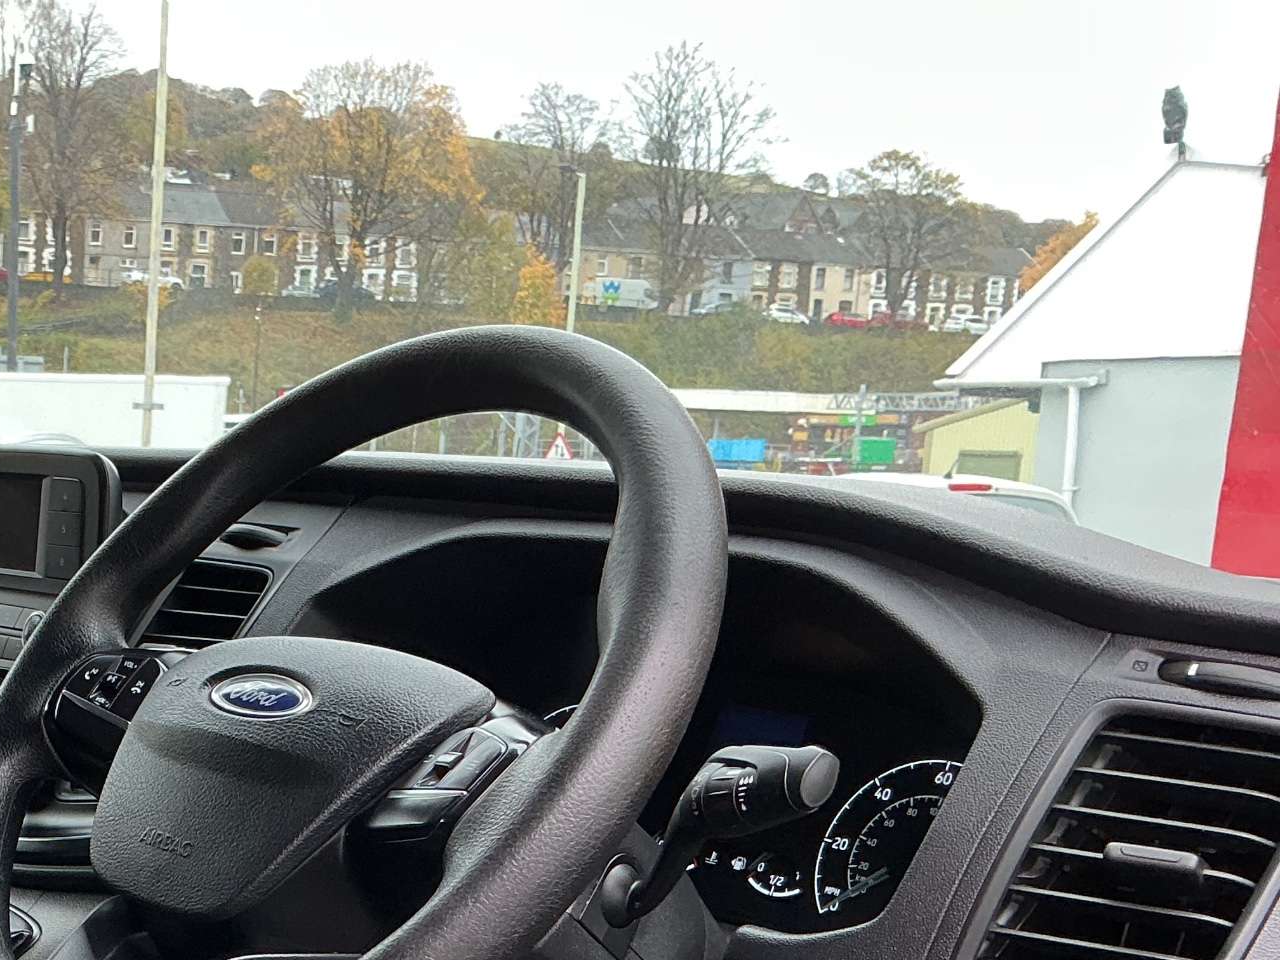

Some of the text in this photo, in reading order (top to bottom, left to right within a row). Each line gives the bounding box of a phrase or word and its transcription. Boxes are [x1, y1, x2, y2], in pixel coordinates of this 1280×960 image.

[229, 685, 288, 707] Ford
[934, 772, 953, 786] 60
[873, 788, 892, 801] 40
[906, 808, 918, 817] 80
[883, 819, 895, 828] 60
[138, 826, 195, 859] AIRBAG
[831, 837, 849, 851] 20
[866, 838, 878, 847] 40
[757, 862, 765, 872] 0
[858, 862, 870, 871] 20
[769, 875, 784, 886] 1/2
[824, 886, 841, 897] MPH
